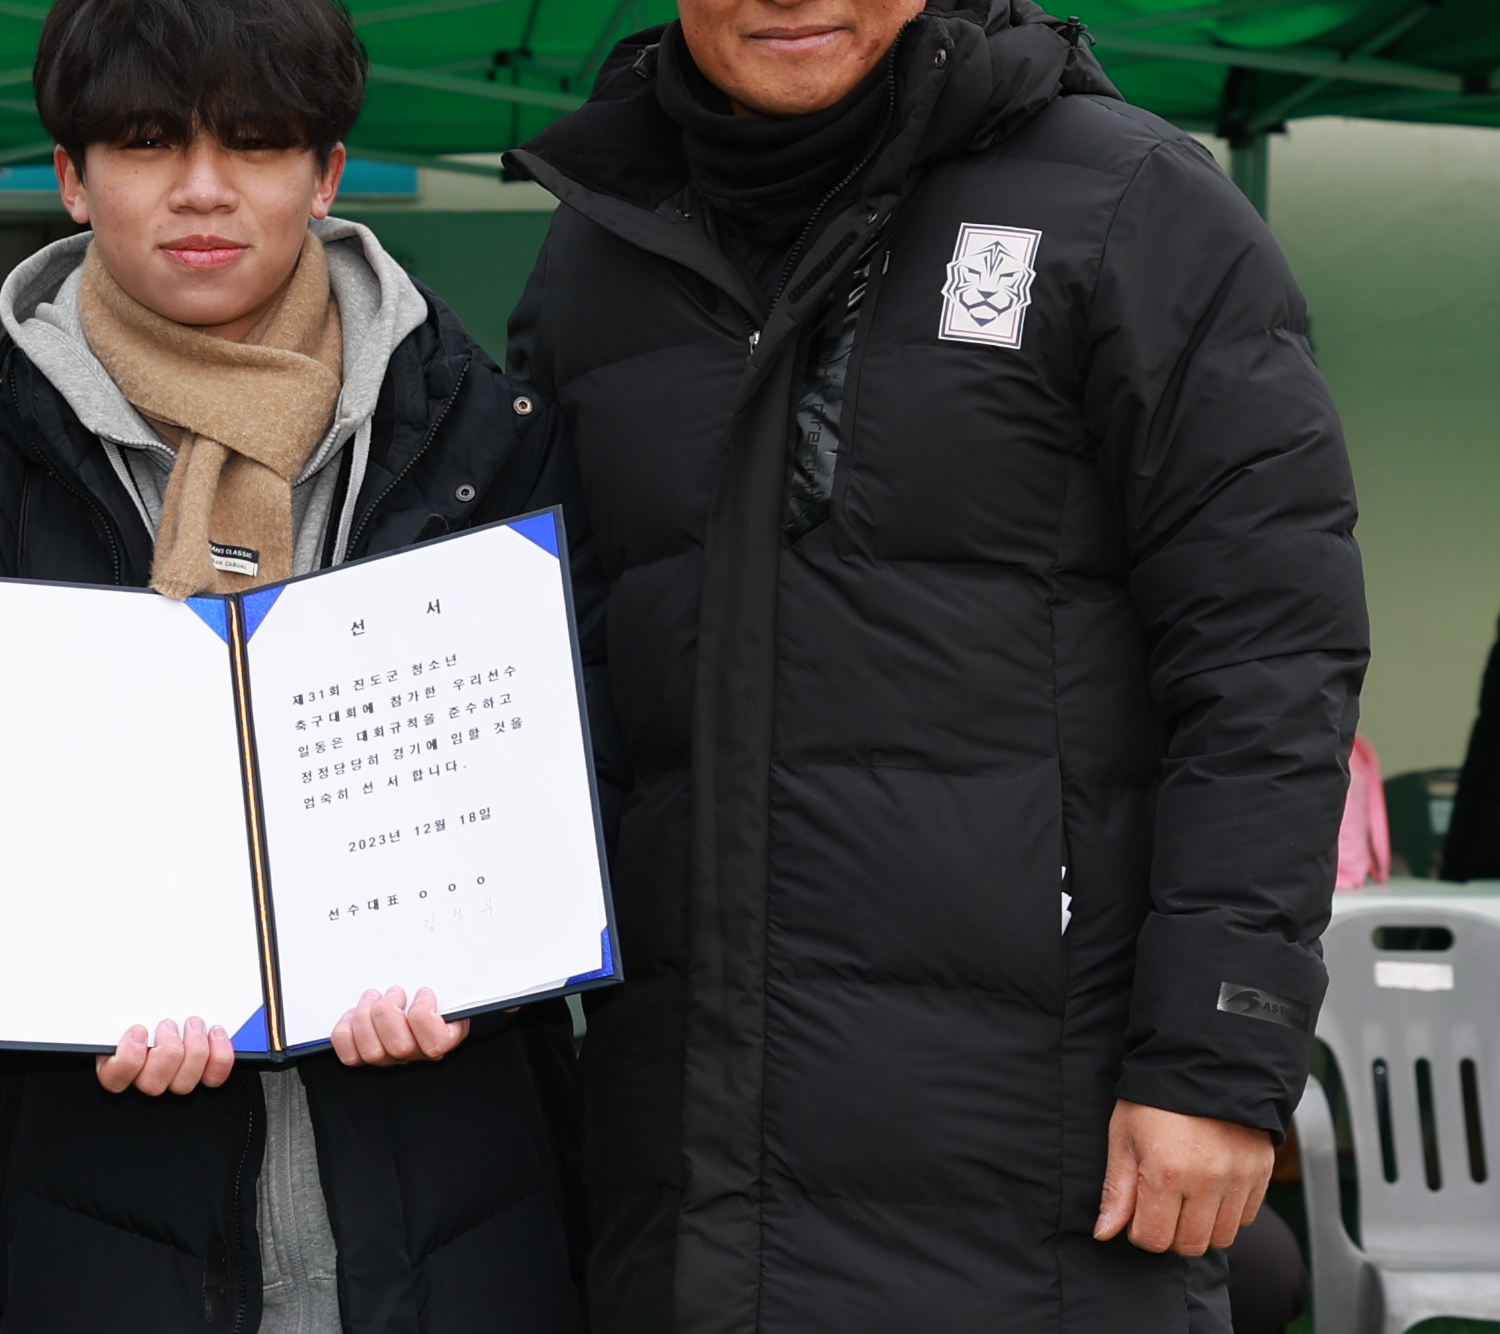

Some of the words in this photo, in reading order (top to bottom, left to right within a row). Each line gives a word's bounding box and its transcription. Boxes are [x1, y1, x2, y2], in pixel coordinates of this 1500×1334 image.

[292, 684, 339, 705] 제31회
[353, 669, 397, 691] 진도군
[411, 653, 456, 675] 청소년
[295, 701, 374, 731] 축구대회에
[390, 685, 435, 708] 참가한
[453, 665, 515, 690] 우리선수
[297, 736, 342, 758] 일동은
[448, 693, 511, 719] 준수하고
[301, 753, 378, 783] 정정당당히
[392, 738, 437, 760] 경기에
[493, 716, 522, 734] 것을
[303, 787, 348, 809] 엄숙히
[348, 829, 401, 852] 2023년
[414, 818, 445, 835] 12월
[459, 806, 490, 824] 18일
